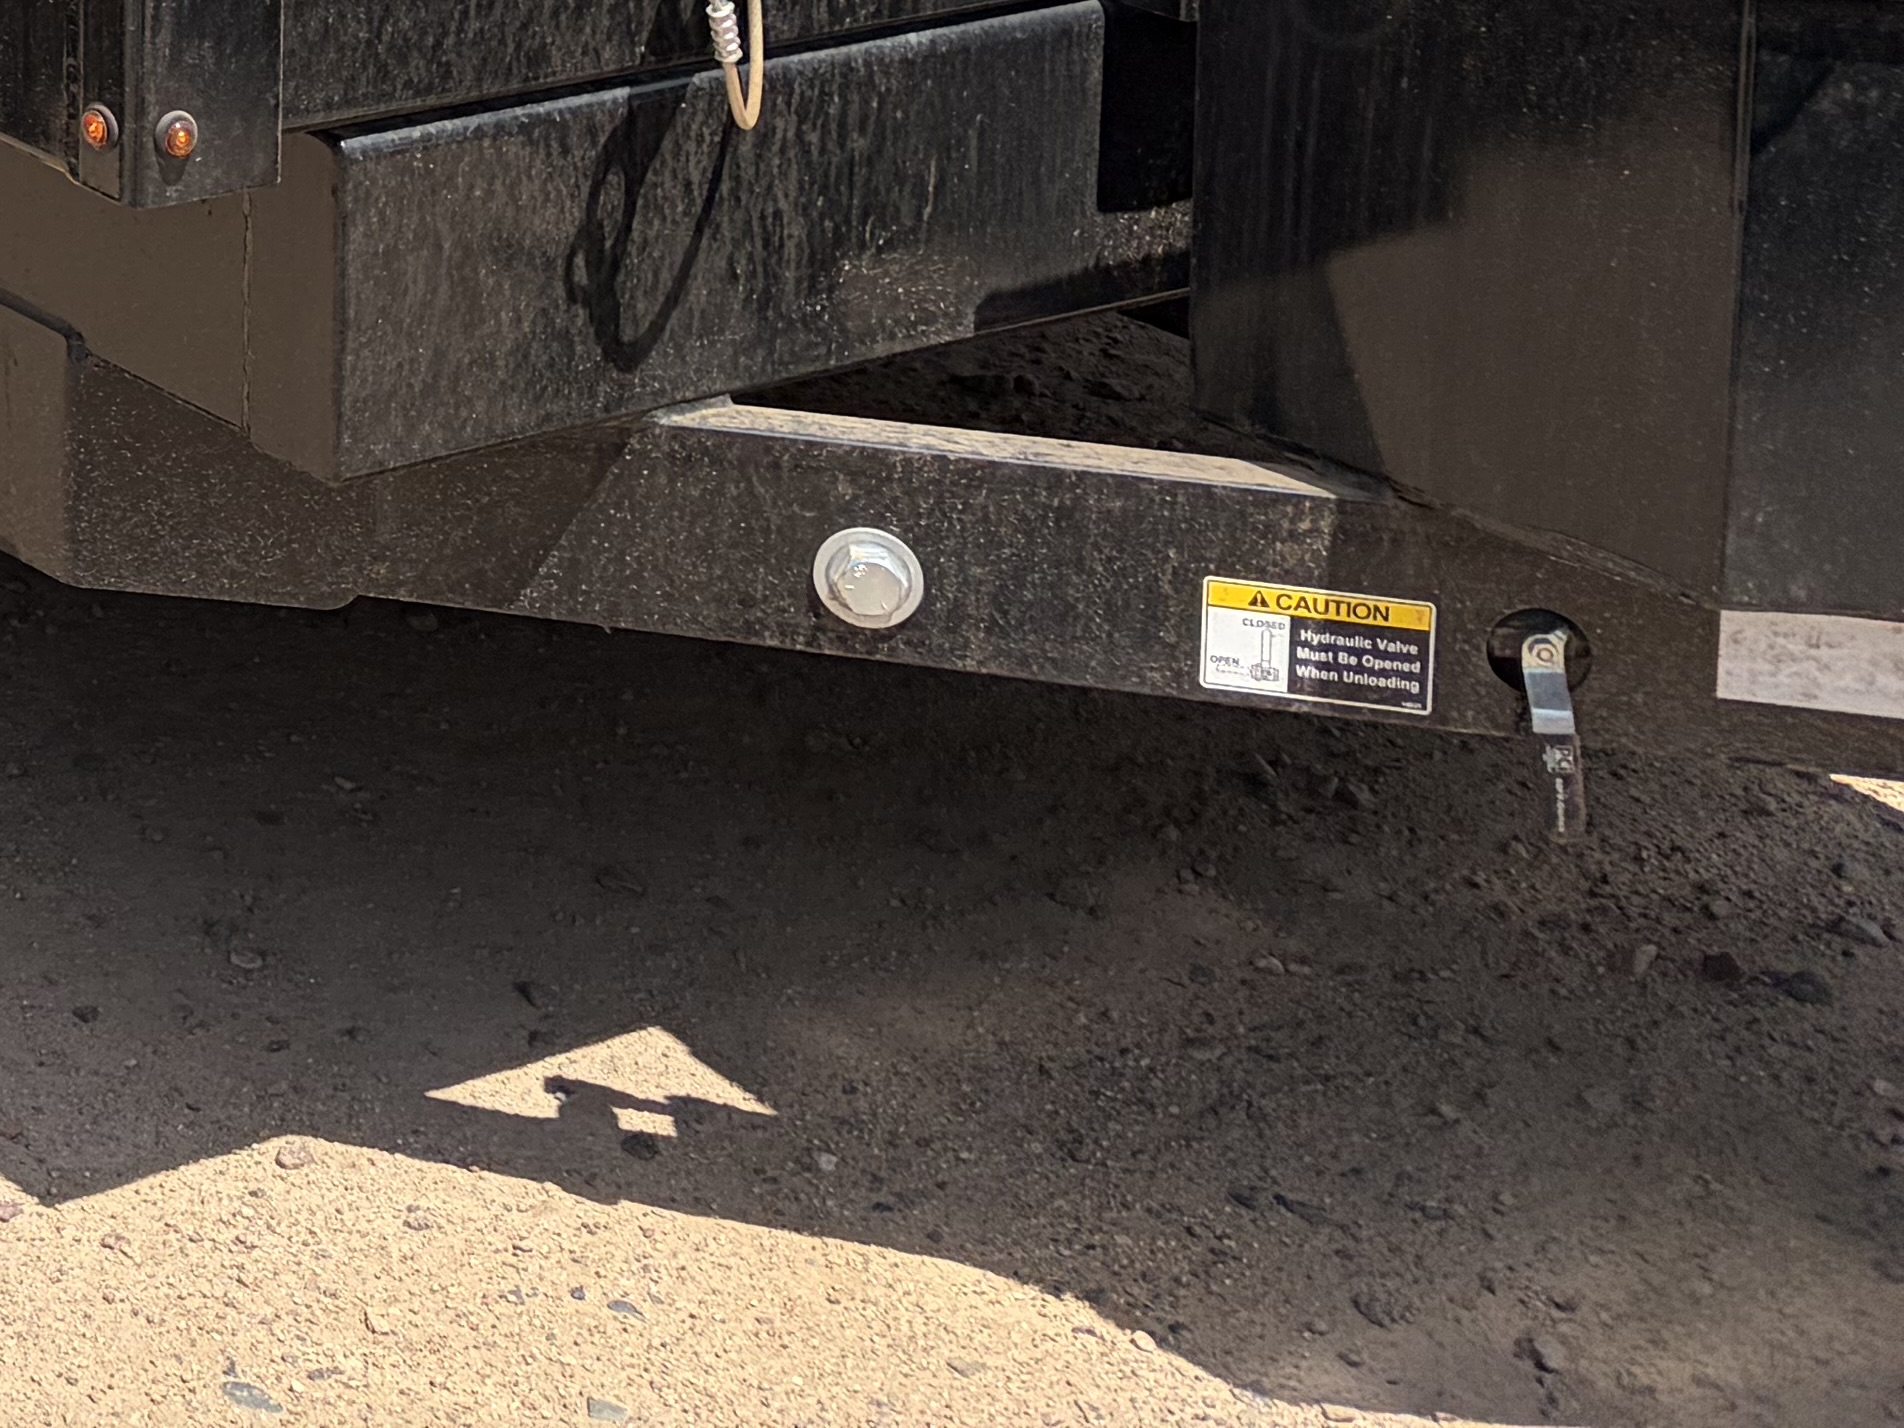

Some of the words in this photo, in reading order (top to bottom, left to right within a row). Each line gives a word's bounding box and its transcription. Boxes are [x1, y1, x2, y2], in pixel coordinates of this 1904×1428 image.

[1275, 593, 1390, 622] CAUTION
[1242, 617, 1286, 630] CLOSED
[1300, 629, 1372, 649] Hydraulic
[1376, 637, 1418, 655] Valve
[1210, 655, 1240, 665] OPEN
[1296, 646, 1333, 663] Must
[1337, 651, 1359, 666] Be
[1362, 654, 1421, 673] Opened
[1296, 664, 1338, 682] When
[1343, 670, 1420, 694] Unloading
